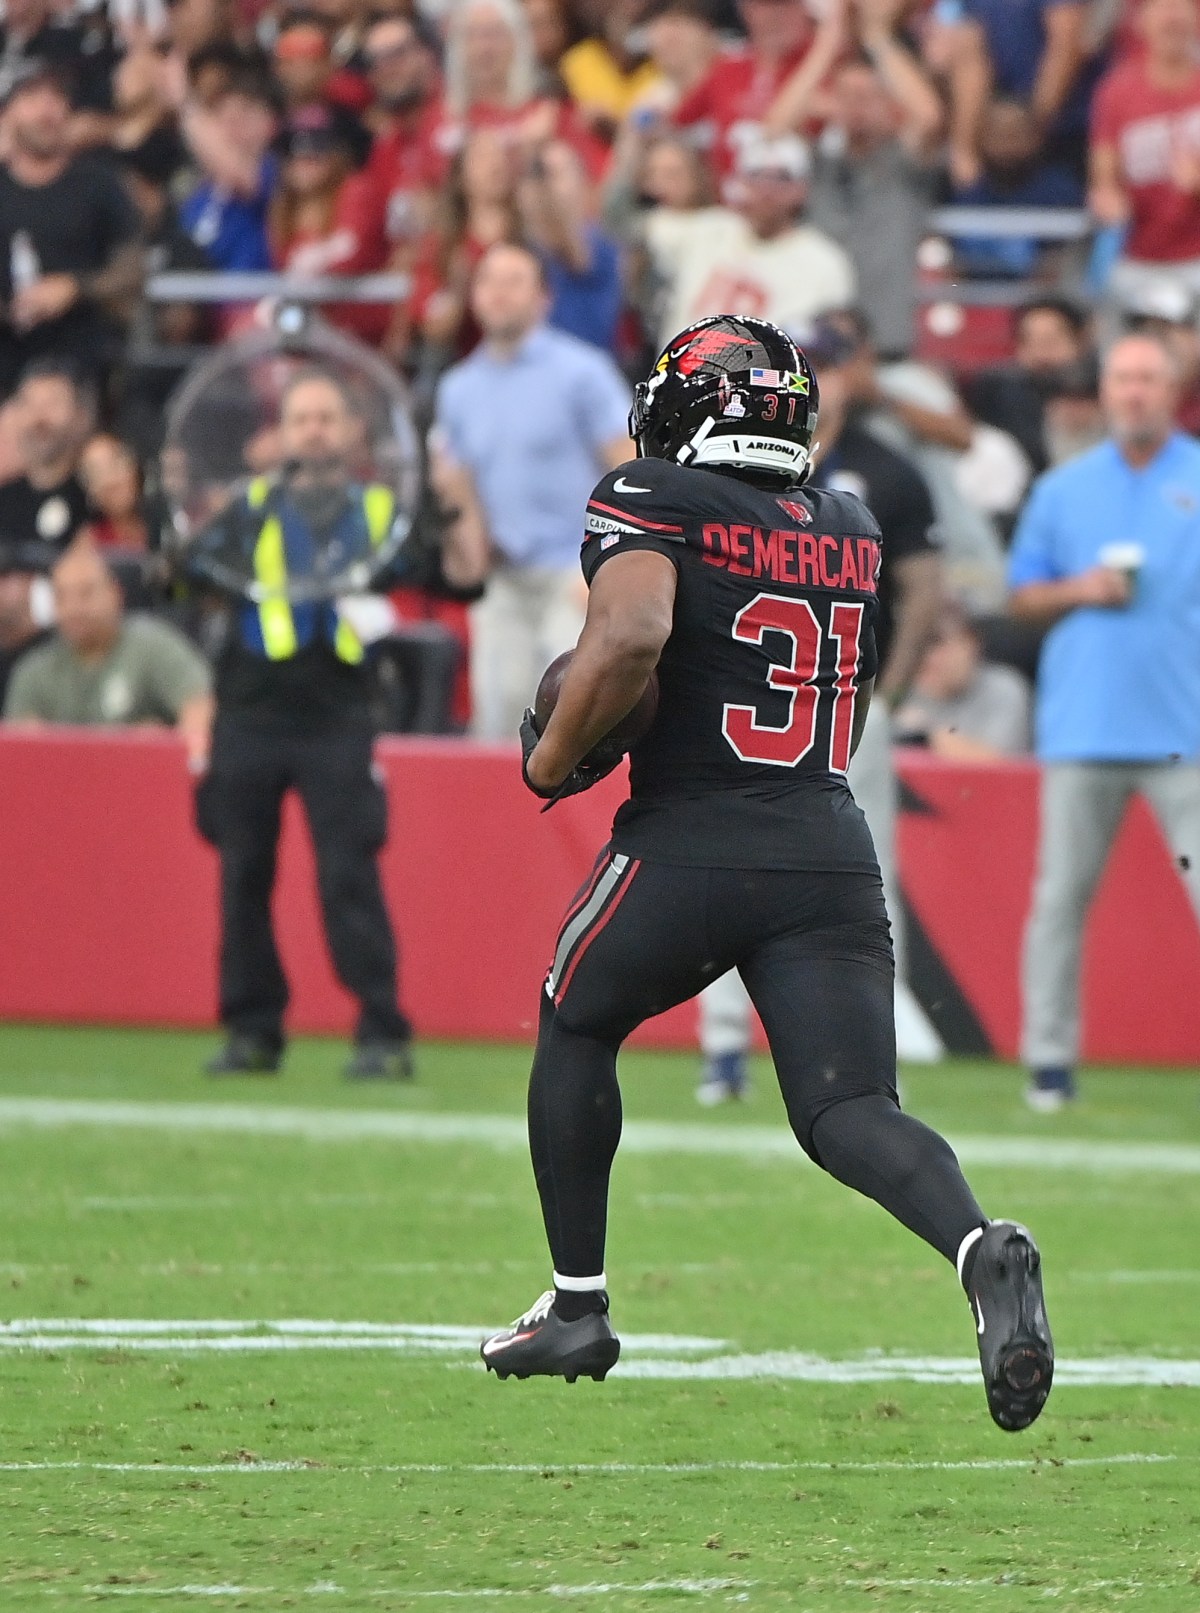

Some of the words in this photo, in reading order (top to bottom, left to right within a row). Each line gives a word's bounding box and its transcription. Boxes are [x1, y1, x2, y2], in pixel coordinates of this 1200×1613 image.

[761, 393, 797, 425] 31
[746, 441, 795, 456] ARIZONA
[721, 592, 864, 774] 31
